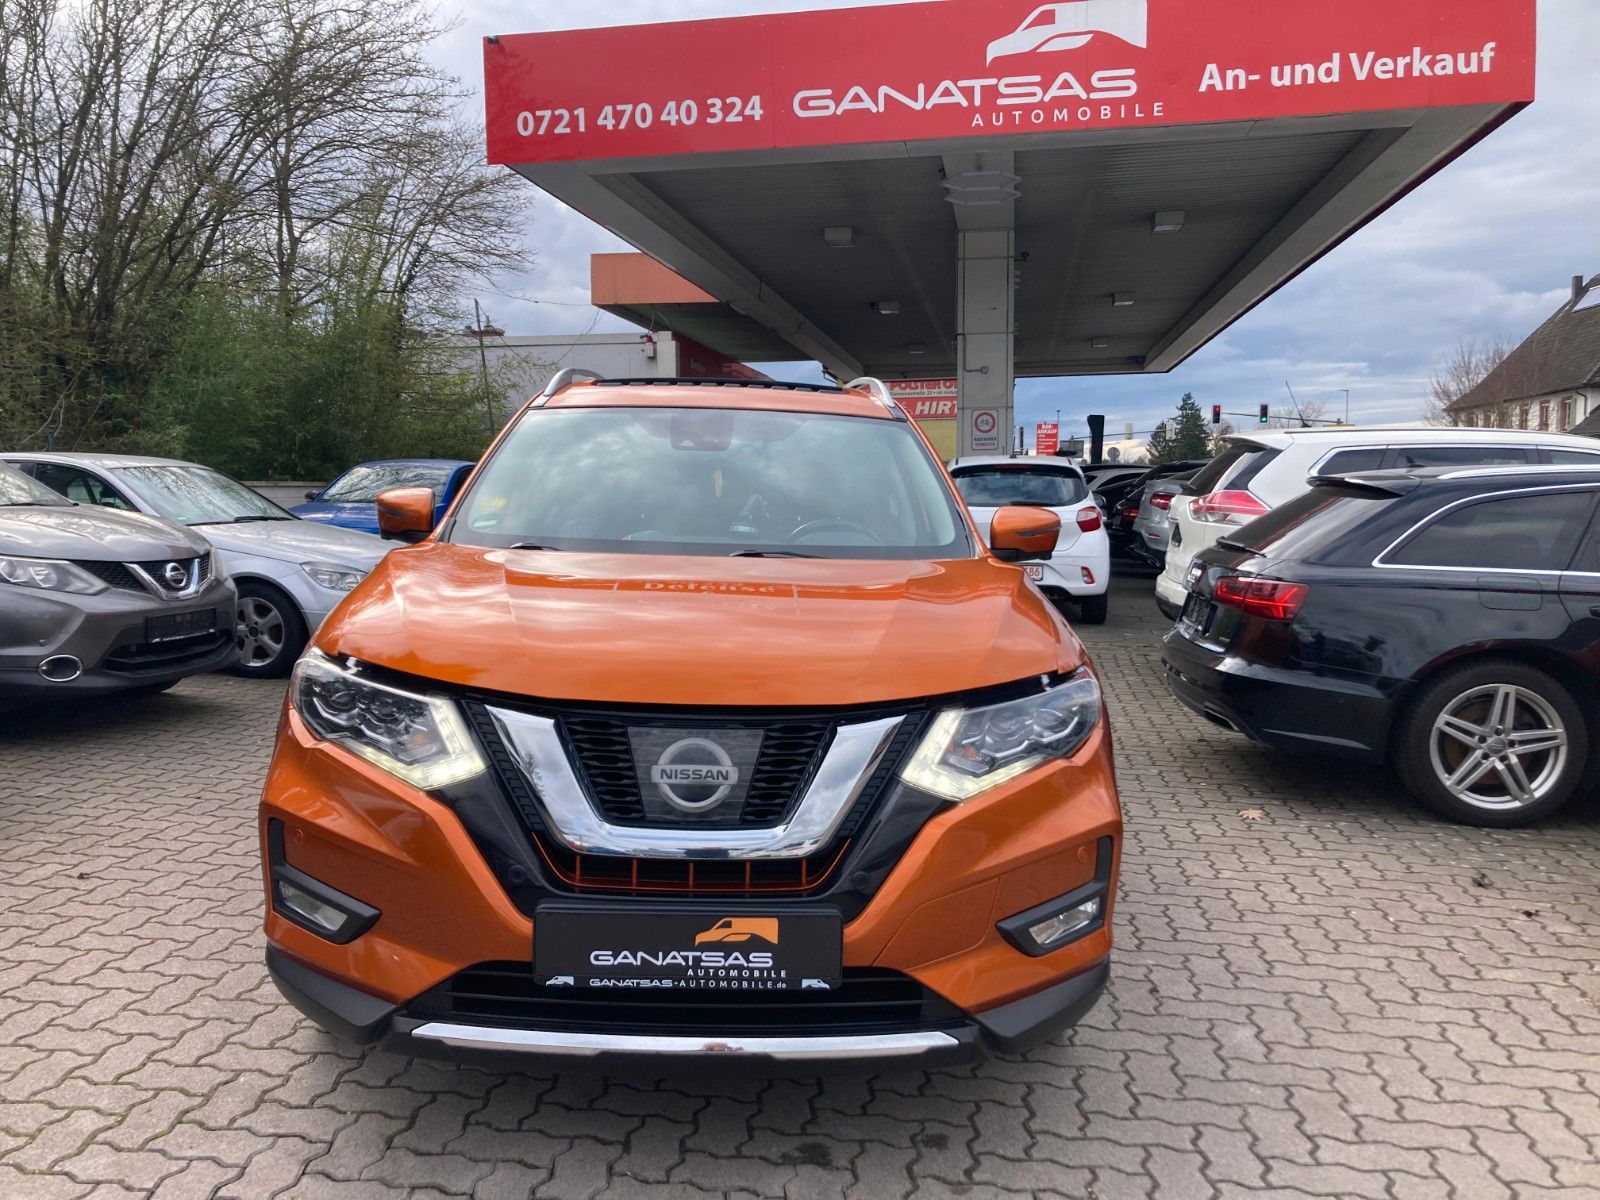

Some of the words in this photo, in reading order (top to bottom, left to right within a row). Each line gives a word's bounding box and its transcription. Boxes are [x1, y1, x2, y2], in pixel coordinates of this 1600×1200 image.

[1199, 62, 1260, 93] An-
[1270, 52, 1341, 89] und
[1348, 41, 1496, 82] Verkauf
[793, 69, 1136, 118] GANATSAS
[516, 105, 587, 137] 0721
[597, 102, 652, 131] 470
[660, 99, 697, 128] 40
[706, 95, 764, 125] 324
[971, 102, 1165, 128] AUTOMOBILE
[660, 769, 729, 781] NISSAN
[589, 950, 773, 967] GANATSAS
[589, 978, 787, 989] GANATSAS-AUTOMOBILE.de
[687, 968, 787, 978] AUTOMOBILE
